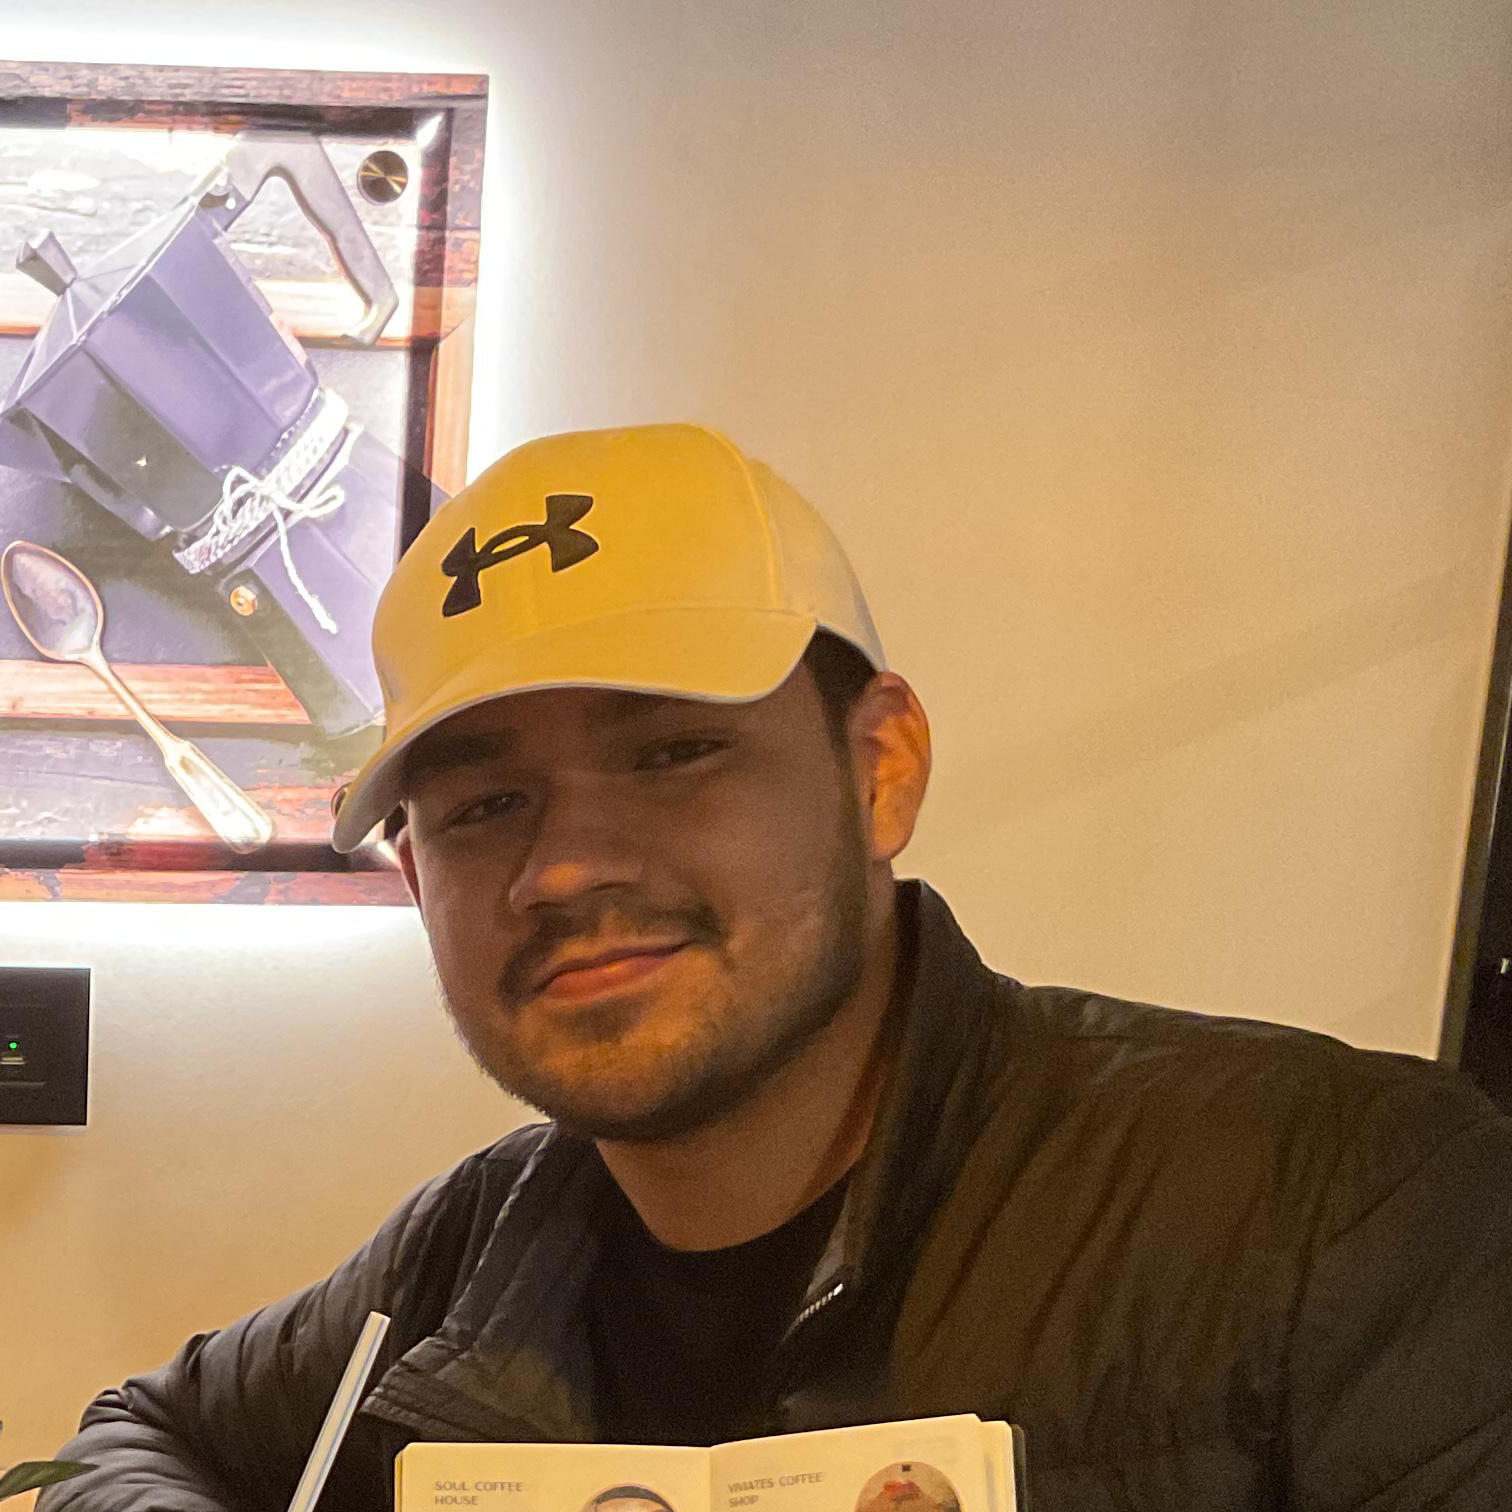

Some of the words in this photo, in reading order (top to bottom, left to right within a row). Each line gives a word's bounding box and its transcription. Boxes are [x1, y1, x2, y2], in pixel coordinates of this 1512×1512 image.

[778, 1472, 824, 1487] COFFEE
[434, 1481, 470, 1492] SOUL
[474, 1481, 524, 1492] COFFEE
[434, 1495, 479, 1506] HOUSE
[728, 1495, 759, 1508] SHOP
